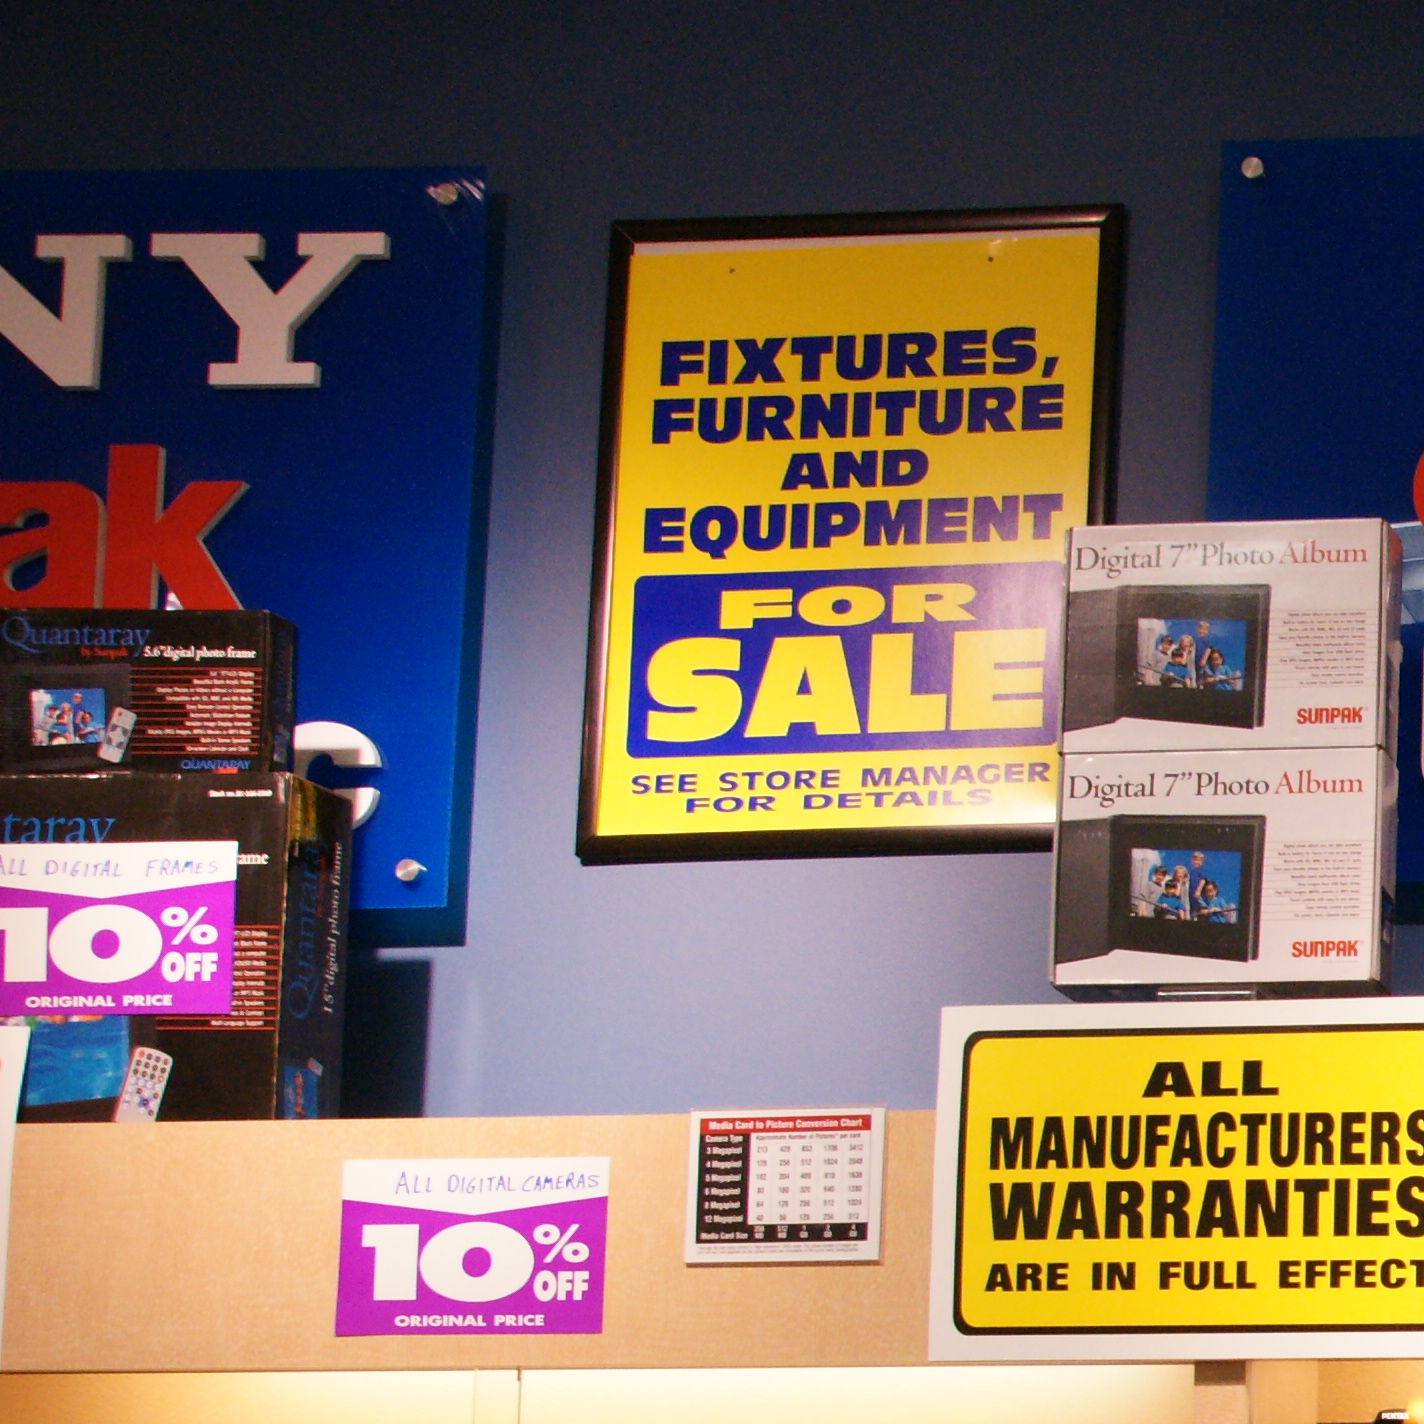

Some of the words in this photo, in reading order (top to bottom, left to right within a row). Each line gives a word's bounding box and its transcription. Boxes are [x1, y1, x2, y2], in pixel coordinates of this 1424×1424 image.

[658, 325, 1059, 387] FIXTURES,
[650, 384, 1063, 446] FURNITURE
[781, 448, 929, 491] AND
[641, 494, 1064, 553] EQUIPMENT
[1075, 544, 1162, 578] Digital
[1201, 542, 1275, 567] Photo
[1278, 539, 1368, 565] Album
[718, 582, 976, 629] FOR
[2, 615, 152, 658] Quantaray
[197, 647, 224, 661] photo
[227, 647, 257, 660] frame
[646, 628, 1044, 743] SALE
[1296, 706, 1363, 725] SUNPAK
[181, 759, 251, 770] QUANTARAY
[630, 772, 698, 794] SEE
[717, 767, 840, 791] STORE
[861, 761, 1050, 788] MANAGER
[684, 794, 776, 814] FOR
[801, 788, 993, 810] DETAILS
[1068, 773, 1156, 808] Digital
[1195, 772, 1270, 797] Photo
[1274, 769, 1363, 796] Album
[45, 859, 122, 877] DIGITAL
[145, 859, 219, 877] FRAMES
[1292, 940, 1358, 958] SUNPAK
[161, 952, 218, 982] OFF
[25, 995, 116, 1008] ORIGINAL
[123, 994, 172, 1007] PRICE
[1142, 1060, 1279, 1098] ALL
[708, 1120, 733, 1130] Media
[735, 1120, 754, 1130] Card
[755, 1120, 764, 1129] to
[765, 1119, 793, 1129] Picture
[796, 1119, 838, 1129] Conversion
[840, 1117, 863, 1128] Chart
[395, 1171, 433, 1196] ALL
[447, 1173, 516, 1195] DIGITAL
[521, 1173, 600, 1192] CAMERAS
[533, 1270, 590, 1302] OFF
[985, 1262, 1069, 1292] ARE
[1091, 1261, 1136, 1291] IN
[1158, 1260, 1257, 1290] FULL
[394, 1314, 486, 1328] ORIGINAL
[493, 1314, 545, 1327] PRICE
